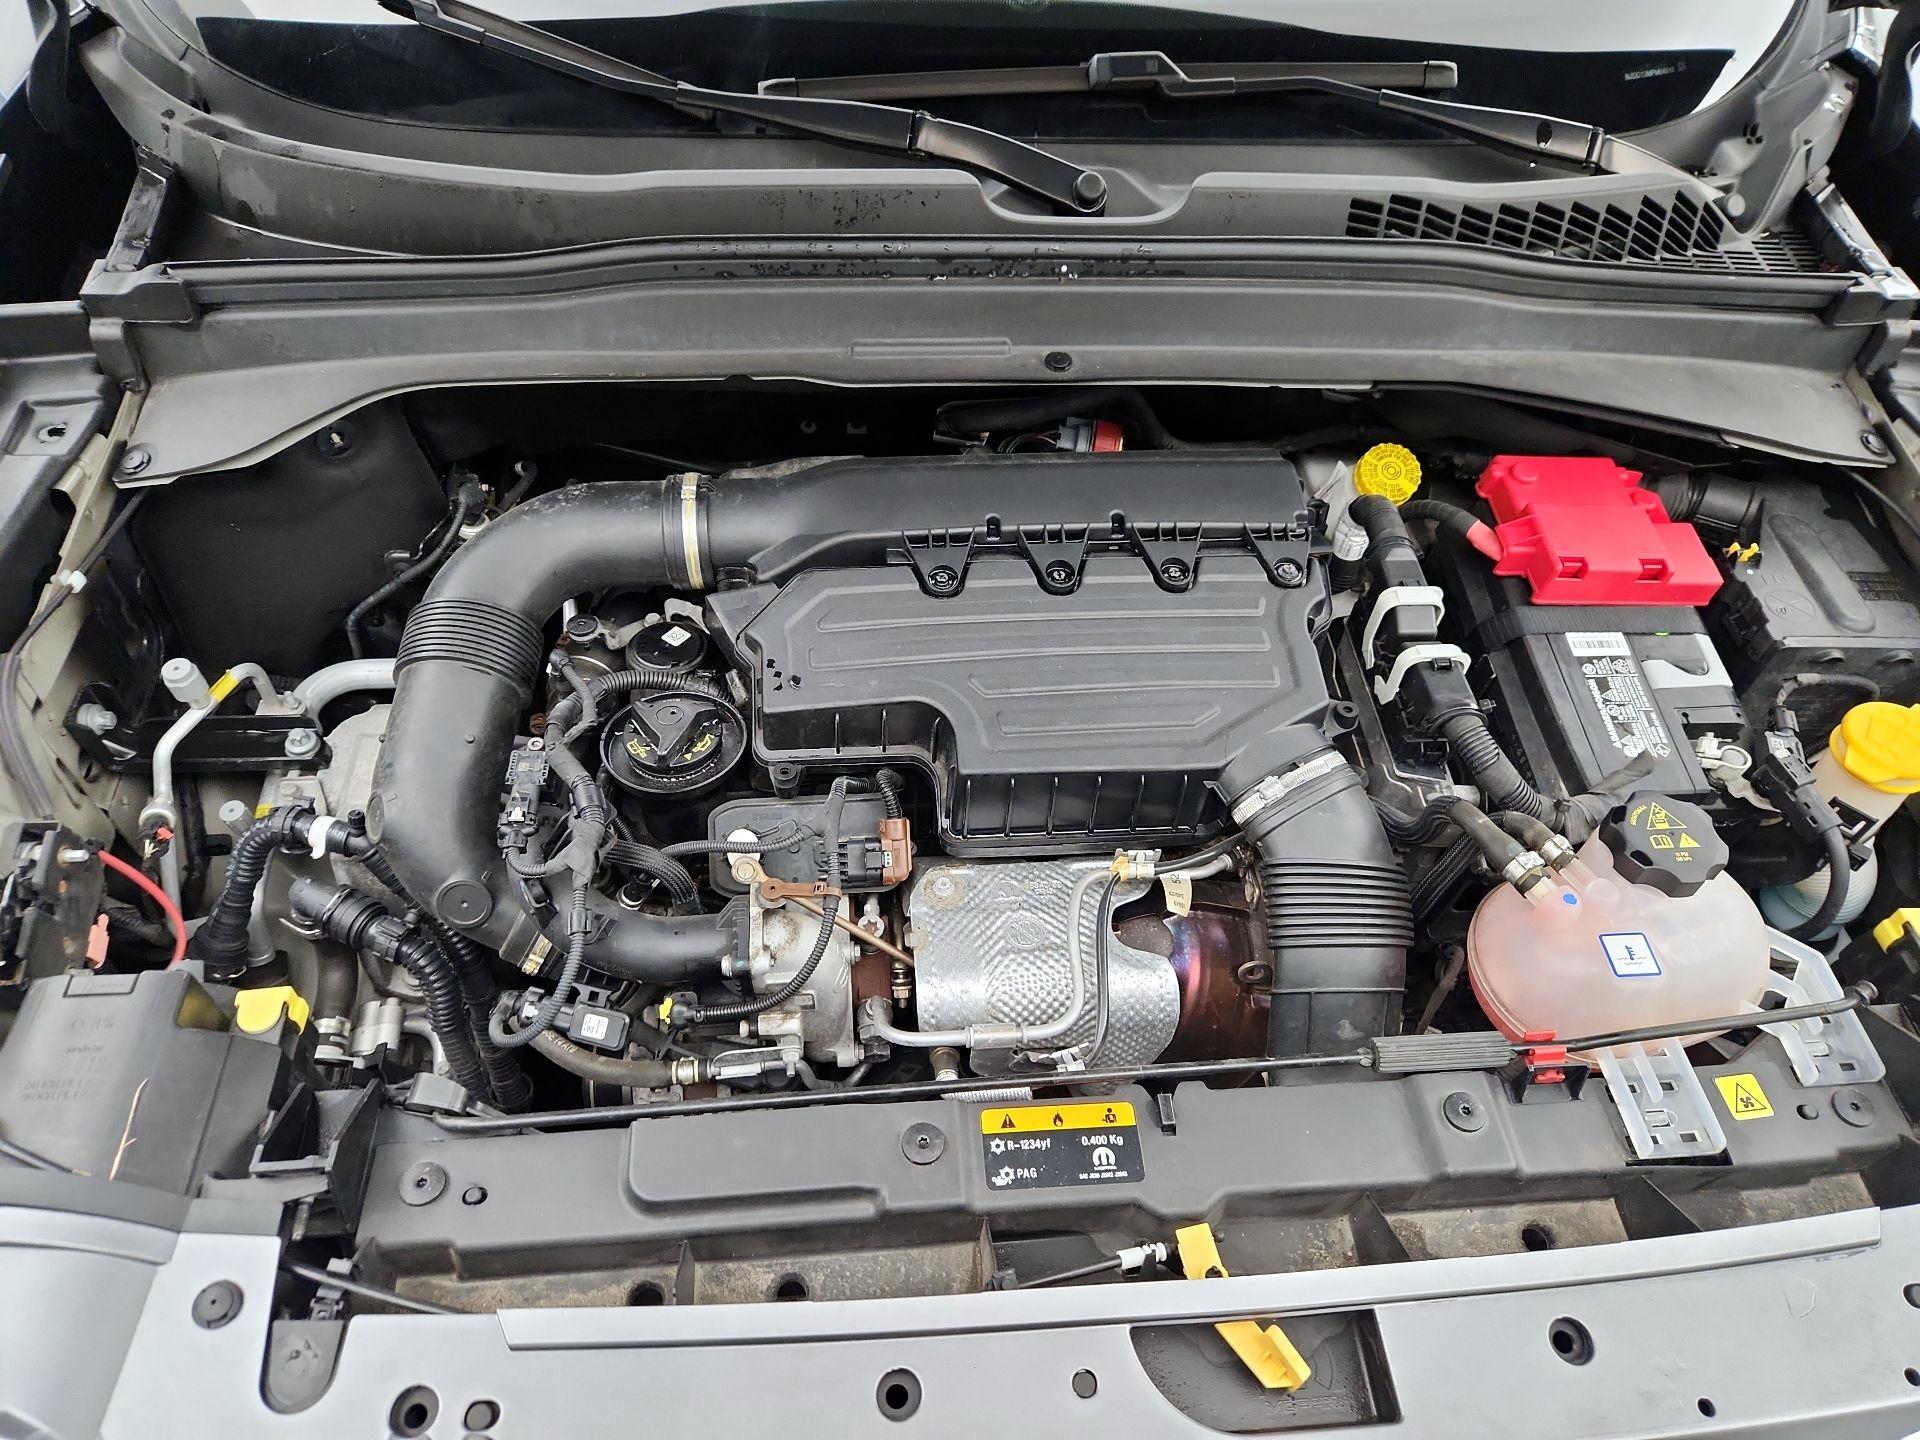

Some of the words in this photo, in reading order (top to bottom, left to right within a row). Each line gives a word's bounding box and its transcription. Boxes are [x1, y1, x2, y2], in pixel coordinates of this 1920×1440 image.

[1006, 1137, 1051, 1151] R-1234yf
[1081, 1134, 1108, 1146] 0.400
[1108, 1134, 1124, 1146] Kg
[1016, 1167, 1038, 1179] PAG
